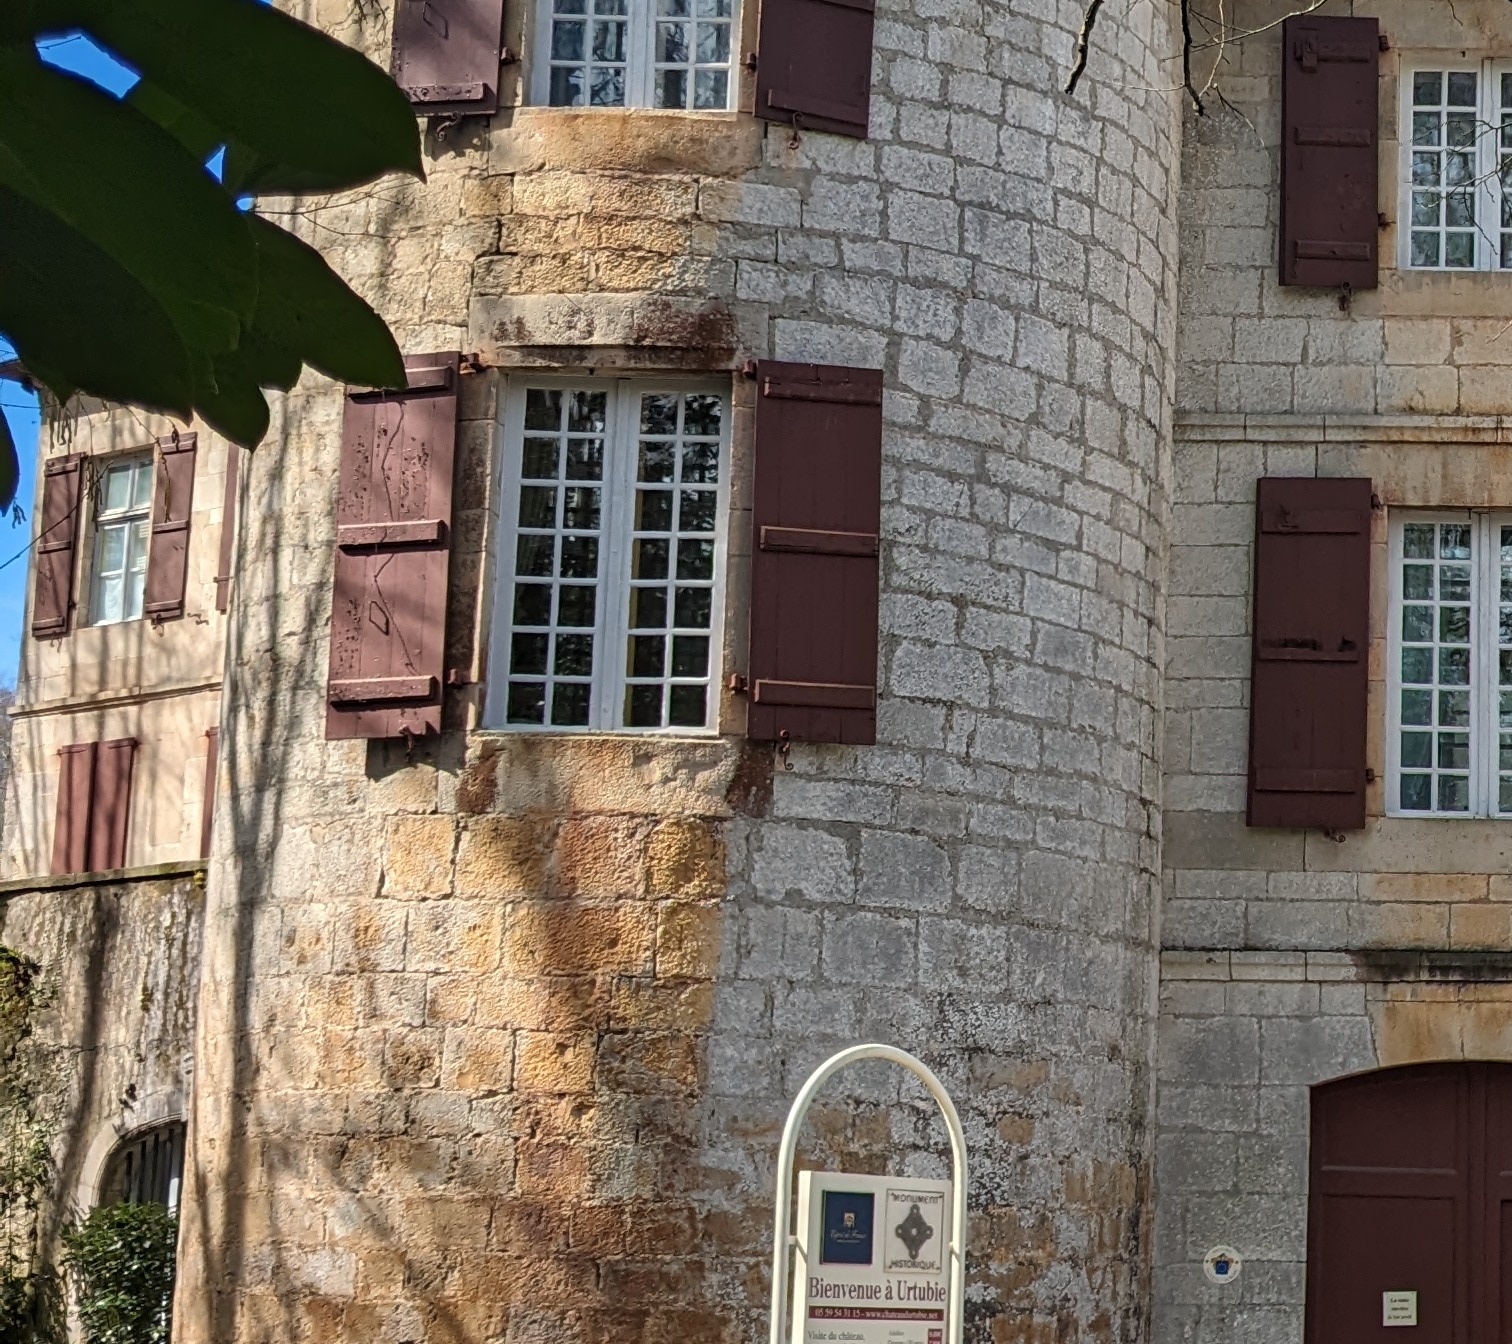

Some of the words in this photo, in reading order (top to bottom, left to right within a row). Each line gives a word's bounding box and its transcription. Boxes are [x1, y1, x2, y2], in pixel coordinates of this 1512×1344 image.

[891, 1193, 943, 1204] MONUMENT
[888, 1259, 940, 1270] HISTORIQUE
[809, 1276, 881, 1300] Bienvenue
[885, 1279, 893, 1300] à
[897, 1279, 946, 1302] Urtubie
[808, 1330, 826, 1340] Visite
[828, 1331, 837, 1340] du
